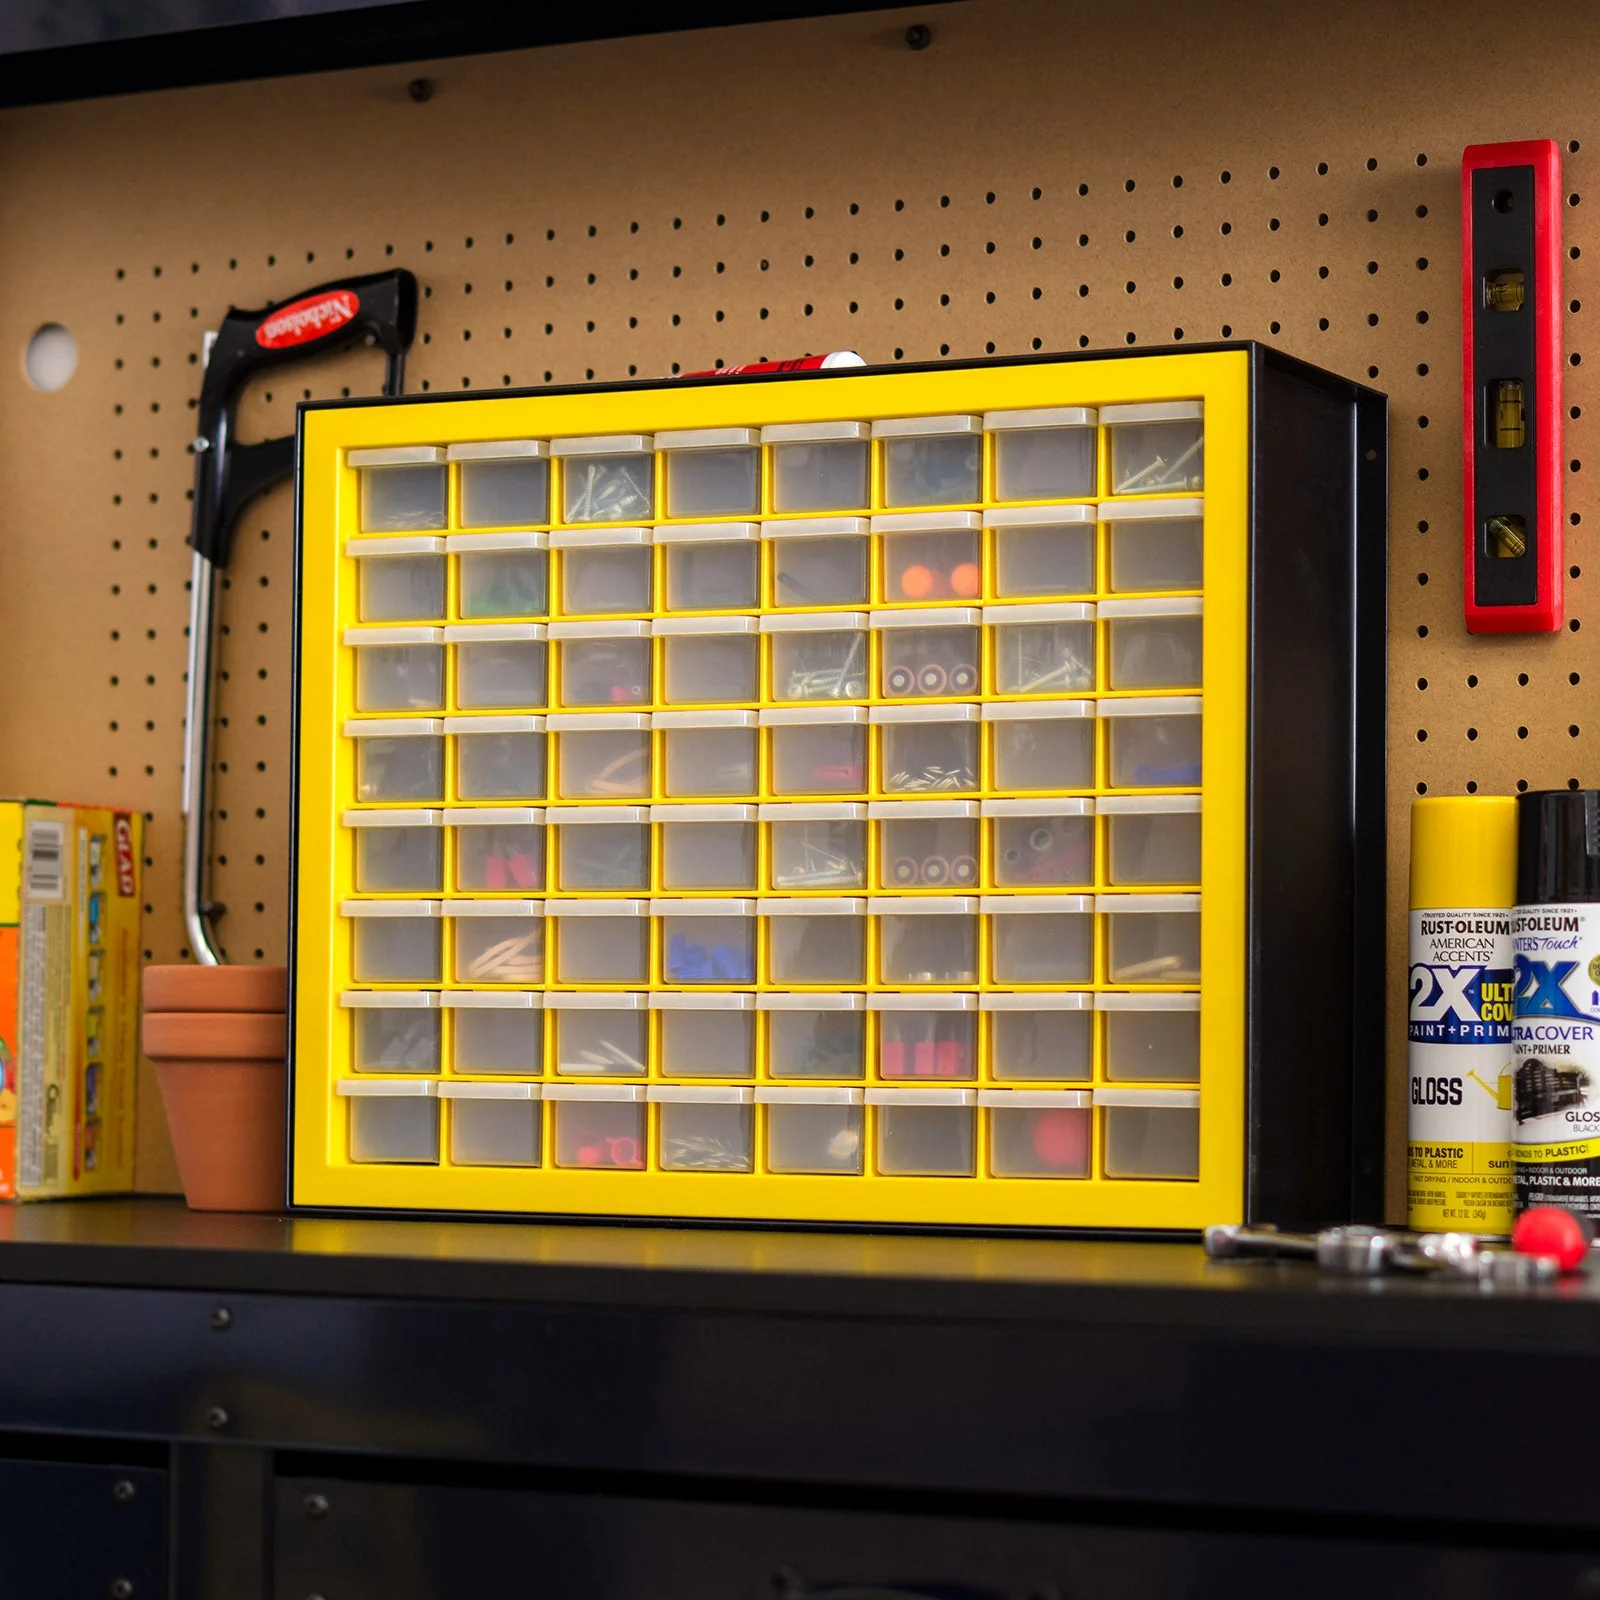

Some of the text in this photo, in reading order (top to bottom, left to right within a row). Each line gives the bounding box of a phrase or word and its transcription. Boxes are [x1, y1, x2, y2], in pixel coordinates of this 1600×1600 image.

[116, 818, 133, 894] GLAD
[1421, 920, 1510, 936] RUST-OLEUM
[1430, 938, 1495, 949] AMERICAN
[1538, 935, 1578, 950] Touch
[1432, 951, 1492, 962] ACCENTS
[1410, 966, 1483, 1021] 2X
[1481, 983, 1514, 1002] ULT
[1481, 1003, 1514, 1022] COV
[1535, 1026, 1594, 1041] COVER
[1411, 1077, 1463, 1105] GLOSS
[1573, 1124, 1600, 1133] BLACK
[1425, 1147, 1464, 1158] PLASTIC
[1436, 1160, 1458, 1169] MORE
[1529, 1176, 1561, 1185] PLASTIC
[1563, 1176, 1571, 1186] &
[1572, 1176, 1600, 1187] MORE
